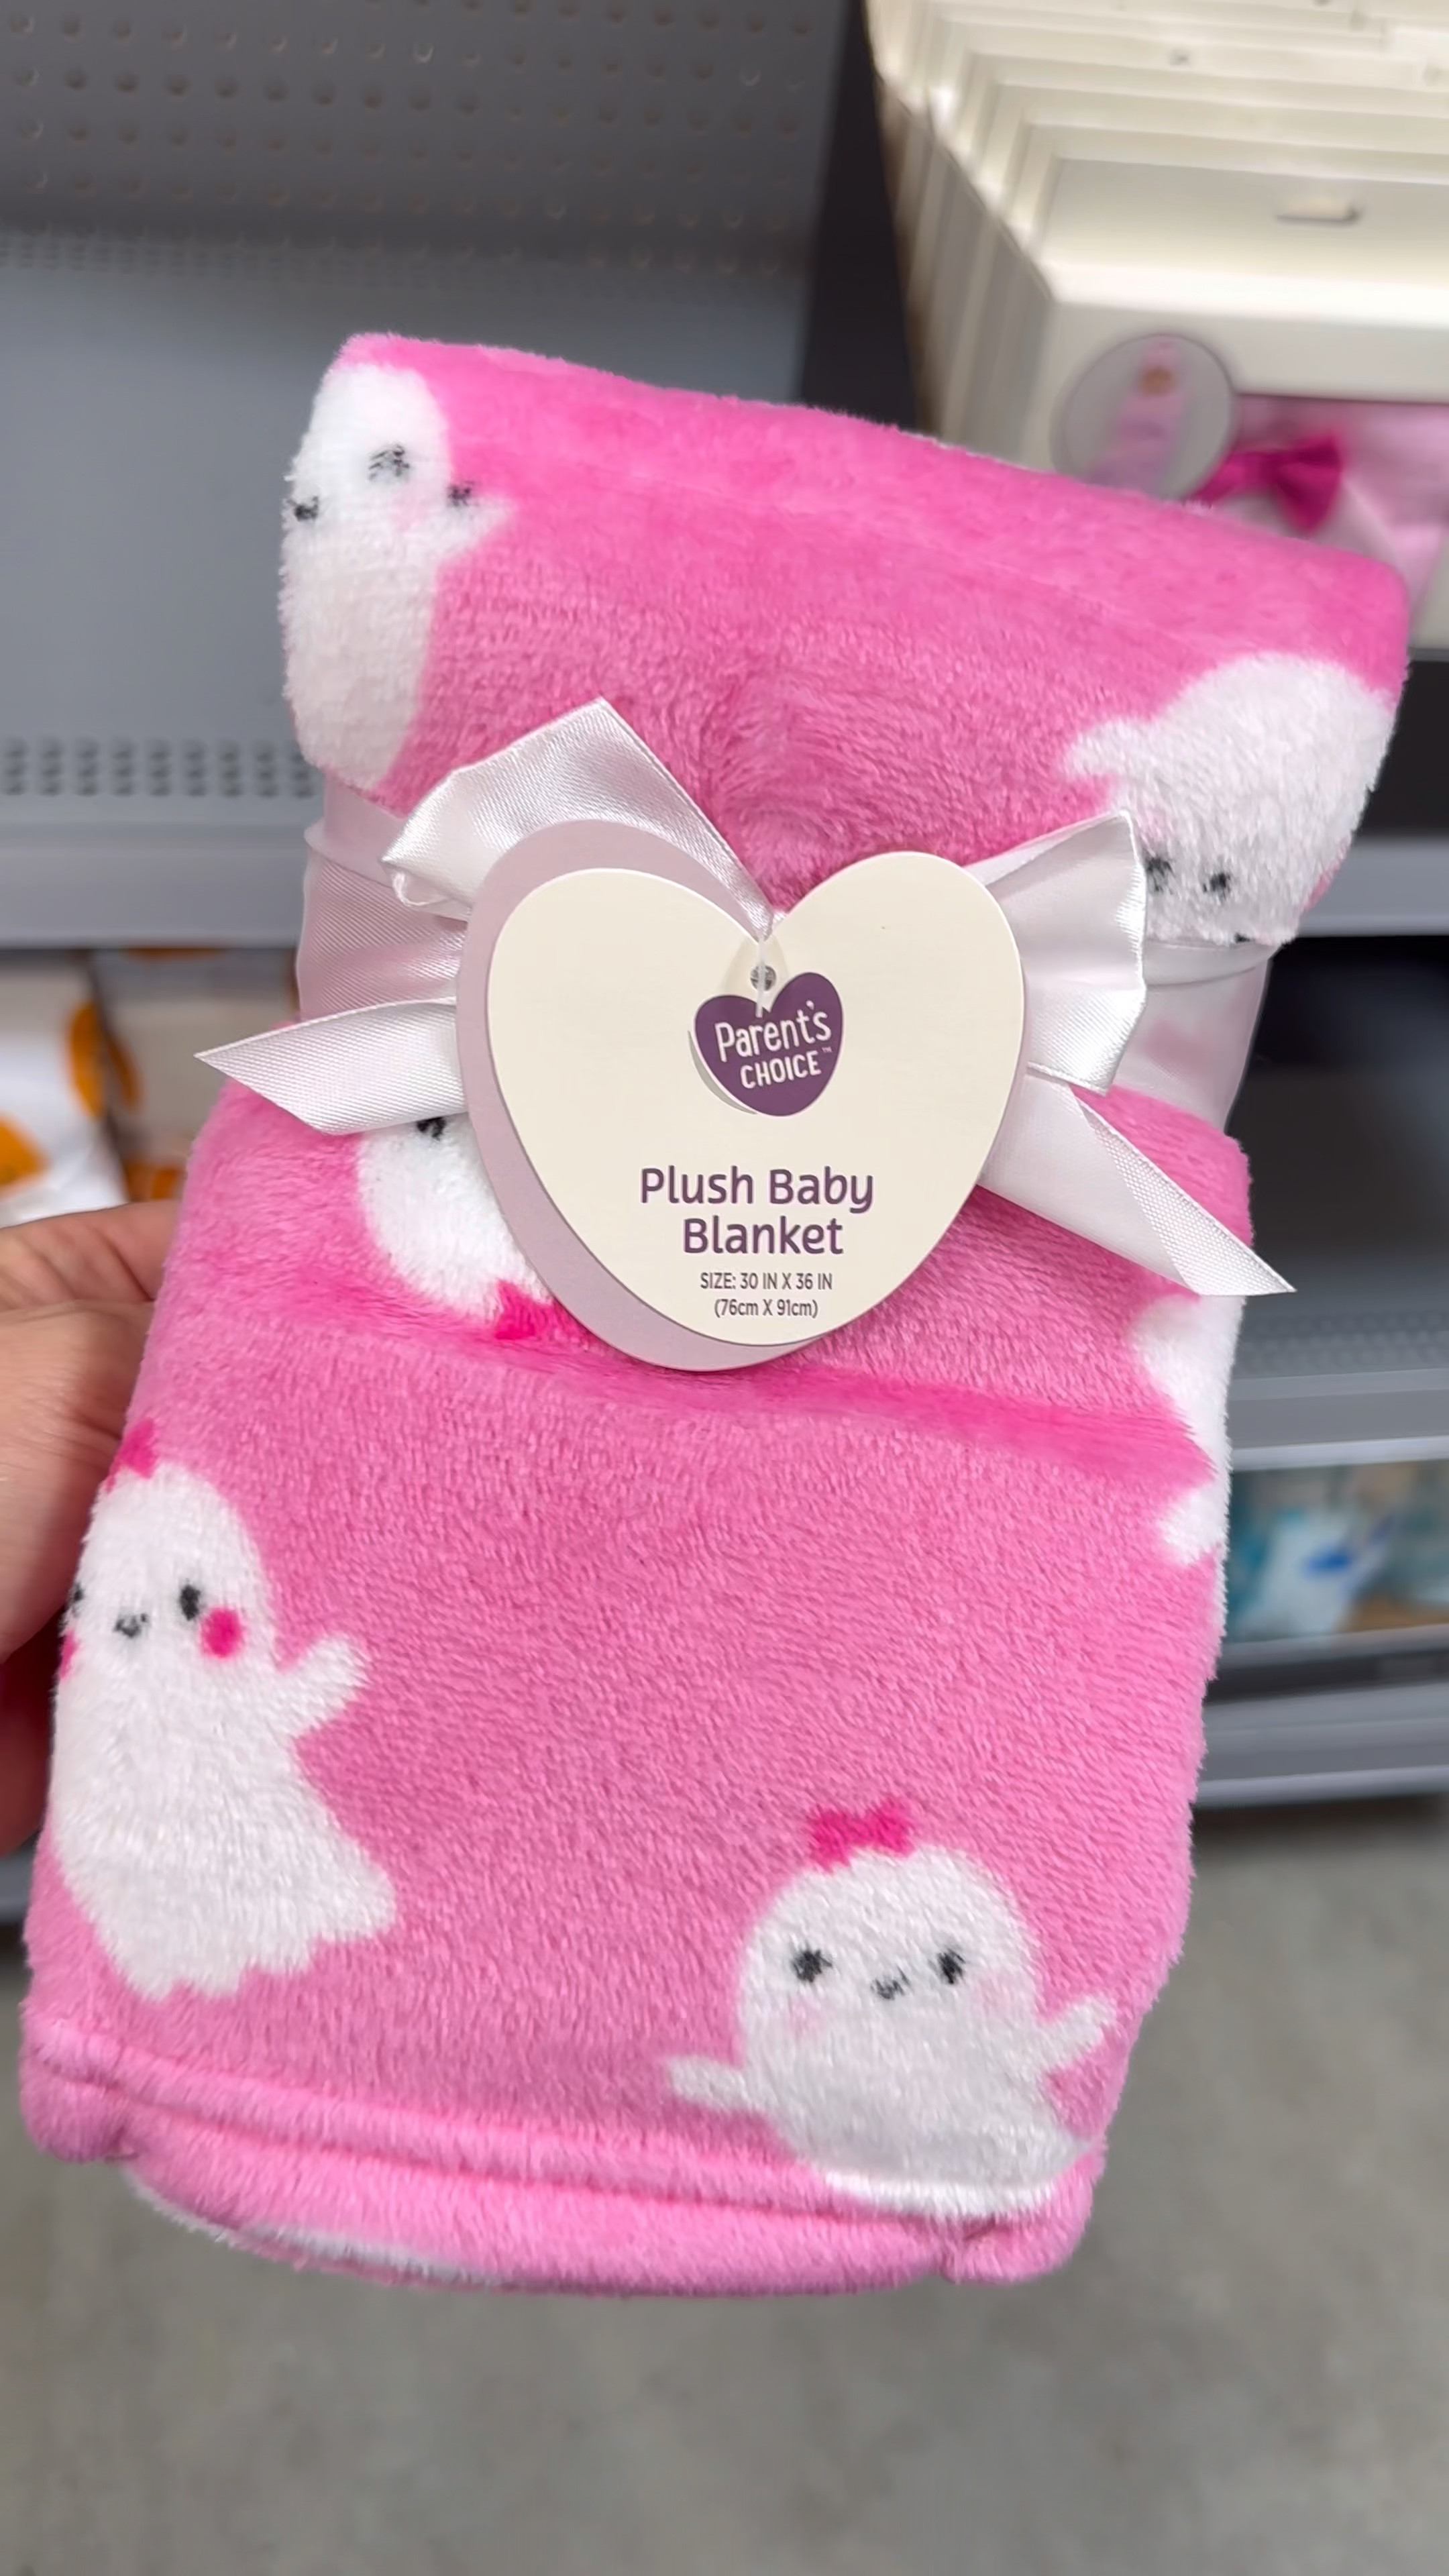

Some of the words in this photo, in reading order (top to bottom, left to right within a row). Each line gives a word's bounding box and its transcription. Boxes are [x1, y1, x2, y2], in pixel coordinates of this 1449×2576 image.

[714, 1000, 832, 1063] Parent's
[740, 1051, 822, 1089] CHOICE
[641, 1165, 753, 1204] Plush
[769, 1166, 874, 1214] Baby
[684, 1216, 844, 1254] Blanket
[700, 1272, 737, 1289] SIZE:
[740, 1272, 759, 1290] 30
[763, 1273, 777, 1289] IN
[781, 1273, 792, 1289] X
[796, 1273, 814, 1290] 36
[818, 1273, 833, 1290] IN
[714, 1299, 759, 1318] (76cm
[762, 1299, 773, 1316] X
[777, 1299, 818, 1318] 91cm)
